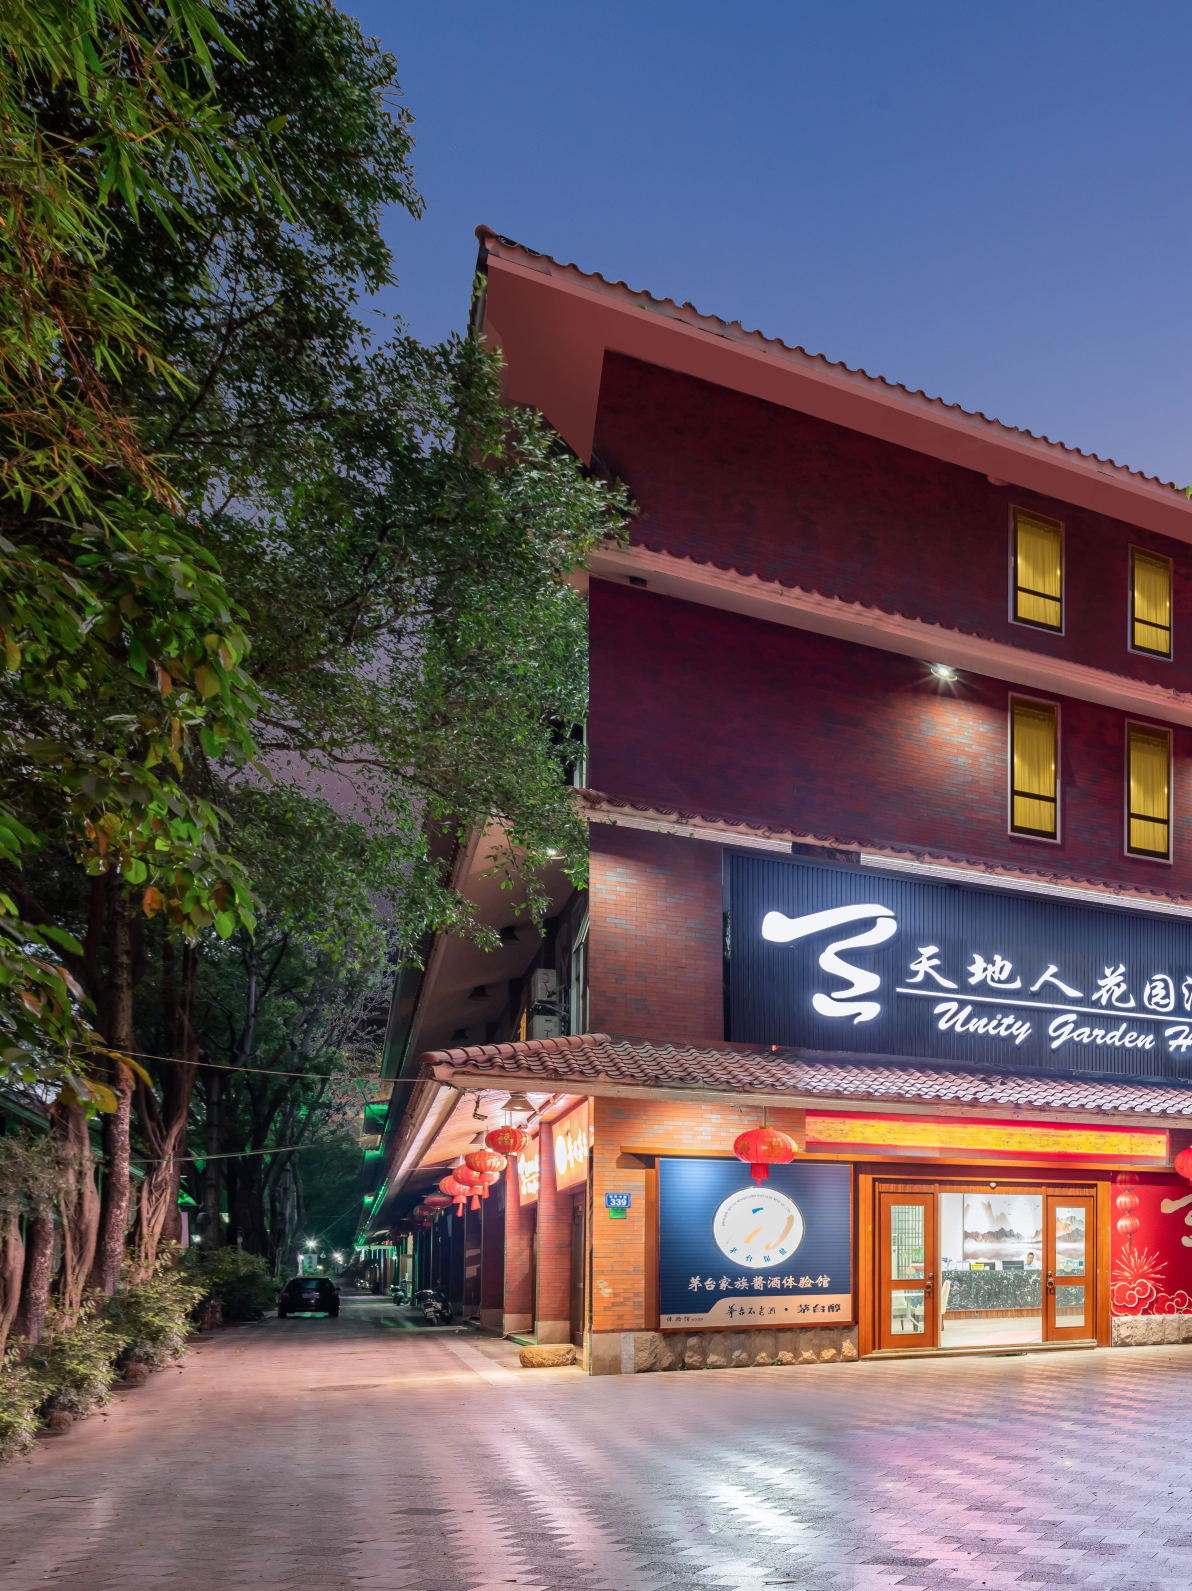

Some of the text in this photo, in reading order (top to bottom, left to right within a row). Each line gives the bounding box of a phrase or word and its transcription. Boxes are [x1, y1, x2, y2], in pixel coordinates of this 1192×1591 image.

[932, 1002, 1033, 1045] Unity
[1048, 1014, 1156, 1051] Garden
[610, 1198, 627, 1206] 339
